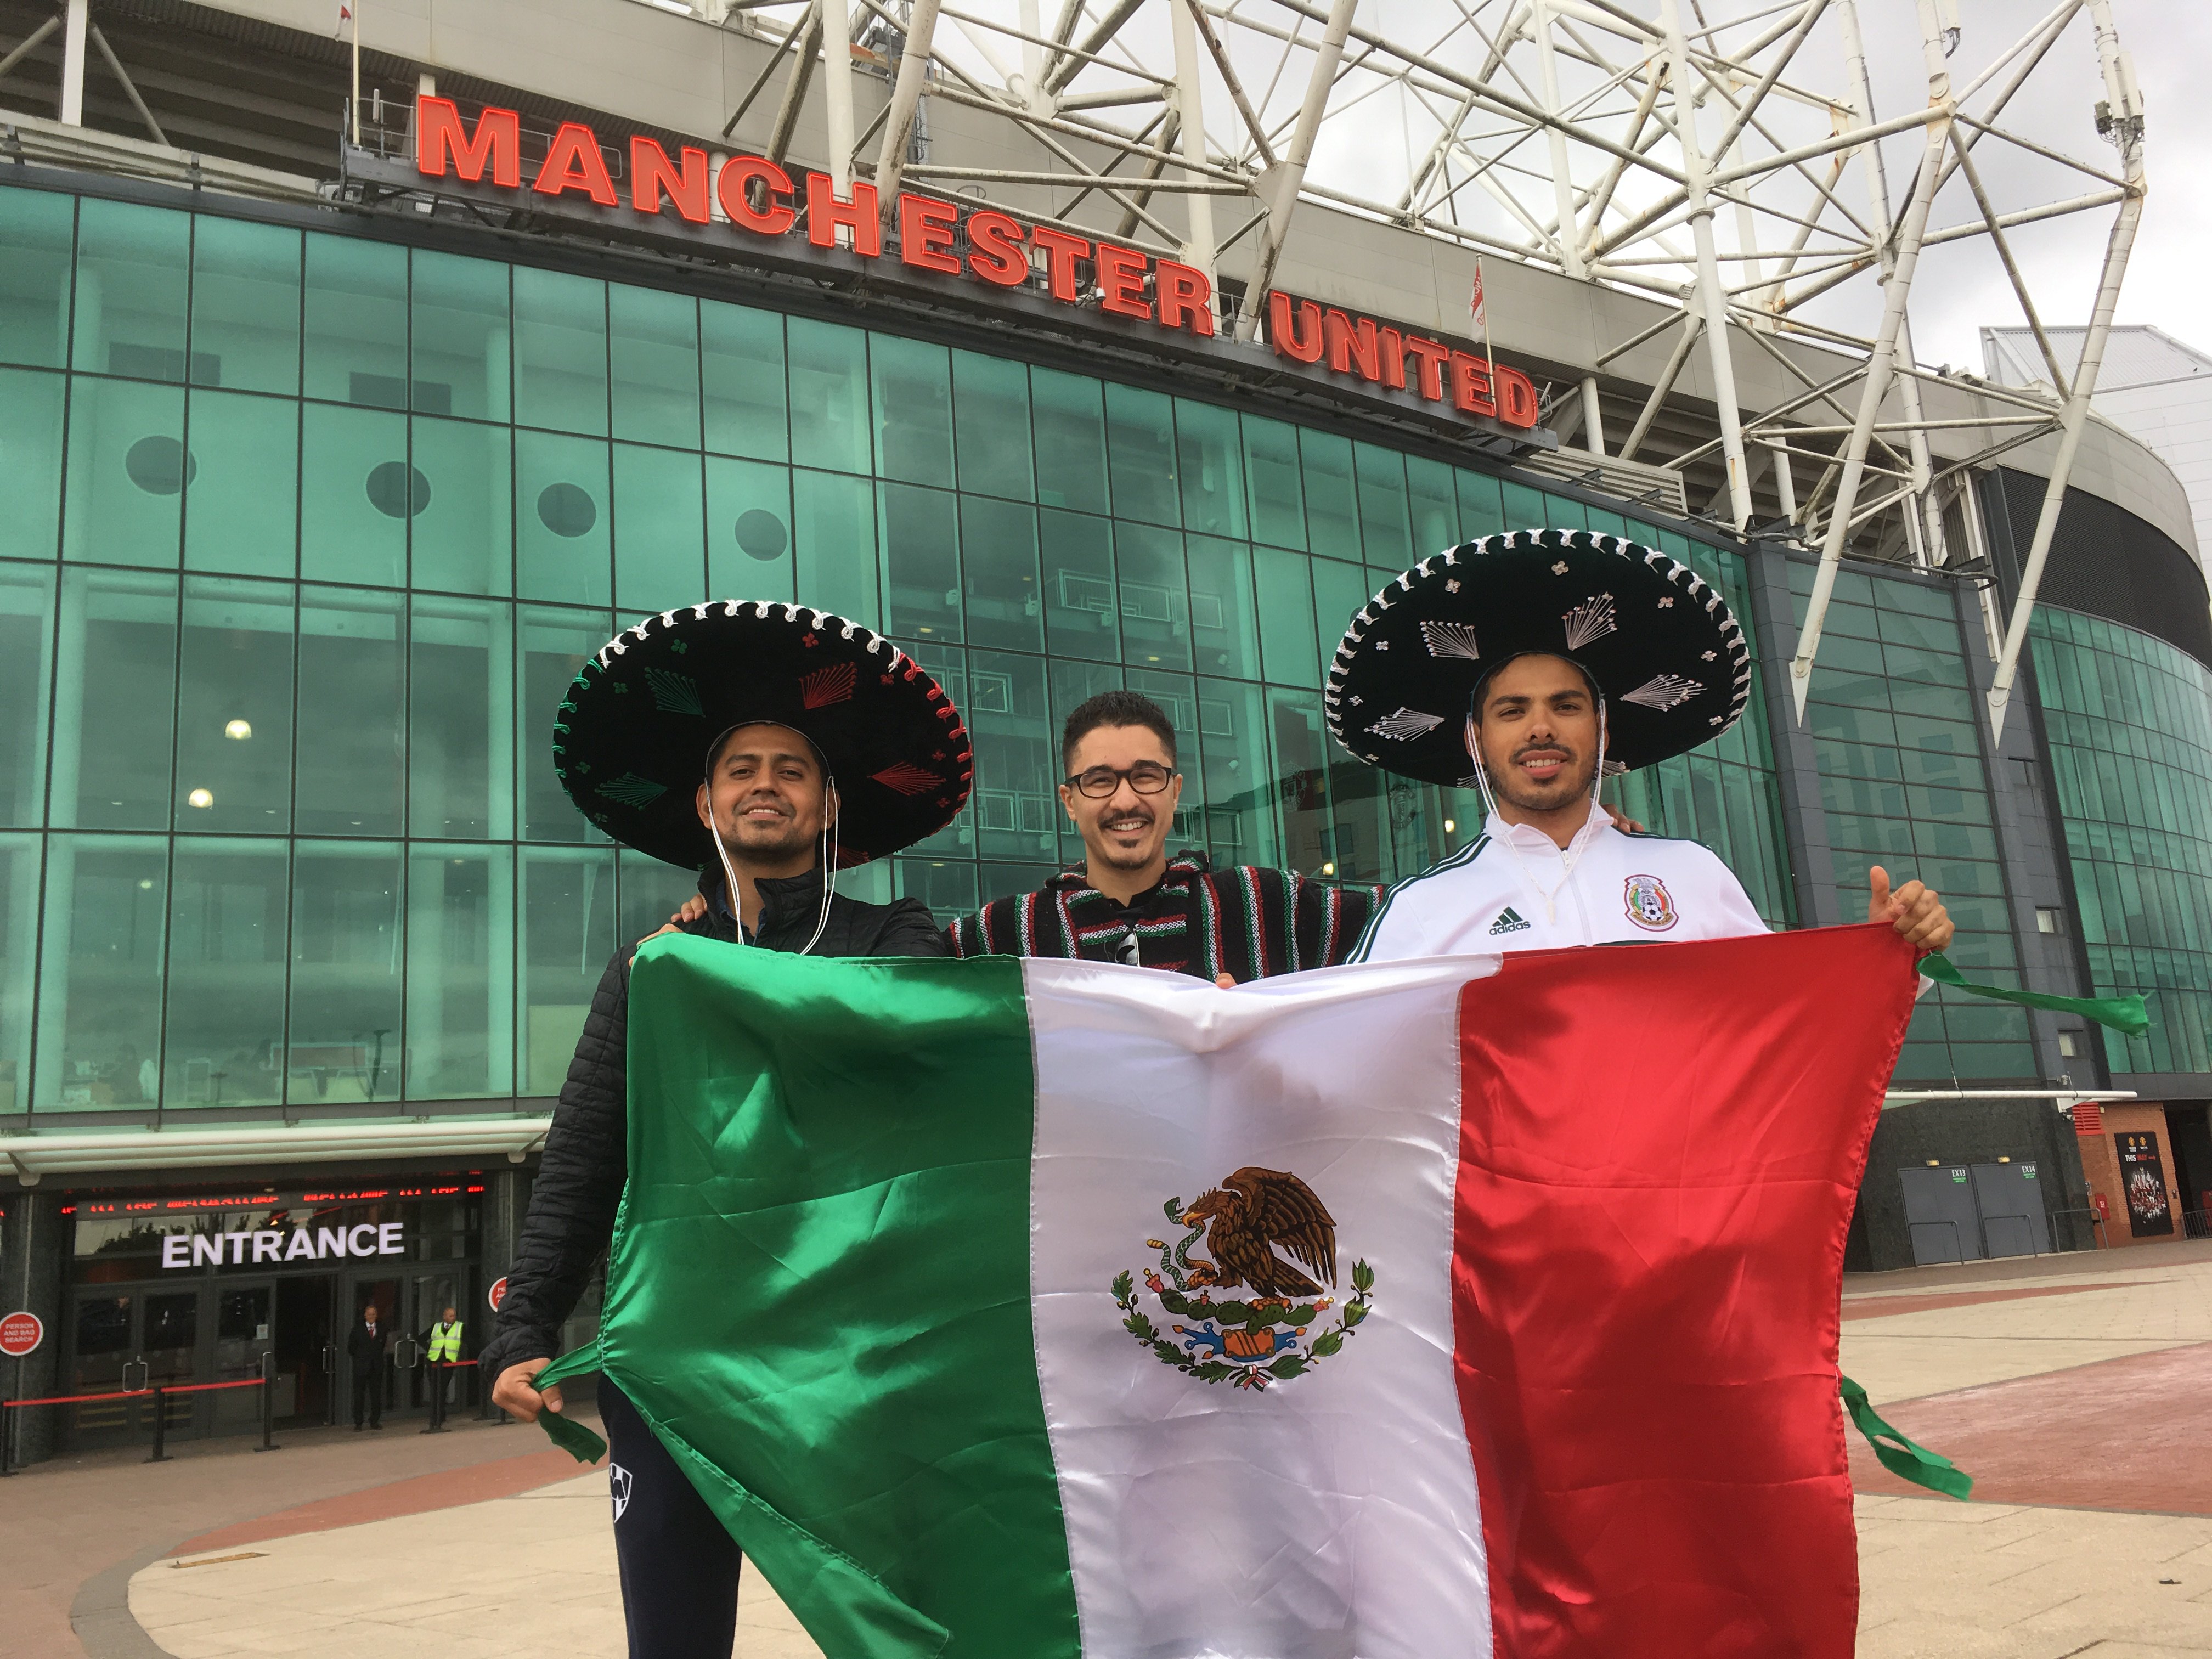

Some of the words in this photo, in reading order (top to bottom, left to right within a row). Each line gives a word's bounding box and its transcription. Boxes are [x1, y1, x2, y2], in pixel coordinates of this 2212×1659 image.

[419, 94, 1215, 338] MANCHESTER
[1269, 289, 1538, 428] UNITED
[1489, 921, 1531, 936] adidas
[1951, 1169, 1966, 1177] EX13
[2022, 1165, 2035, 1173] EX14
[162, 1222, 404, 1268] ENTRANCE
